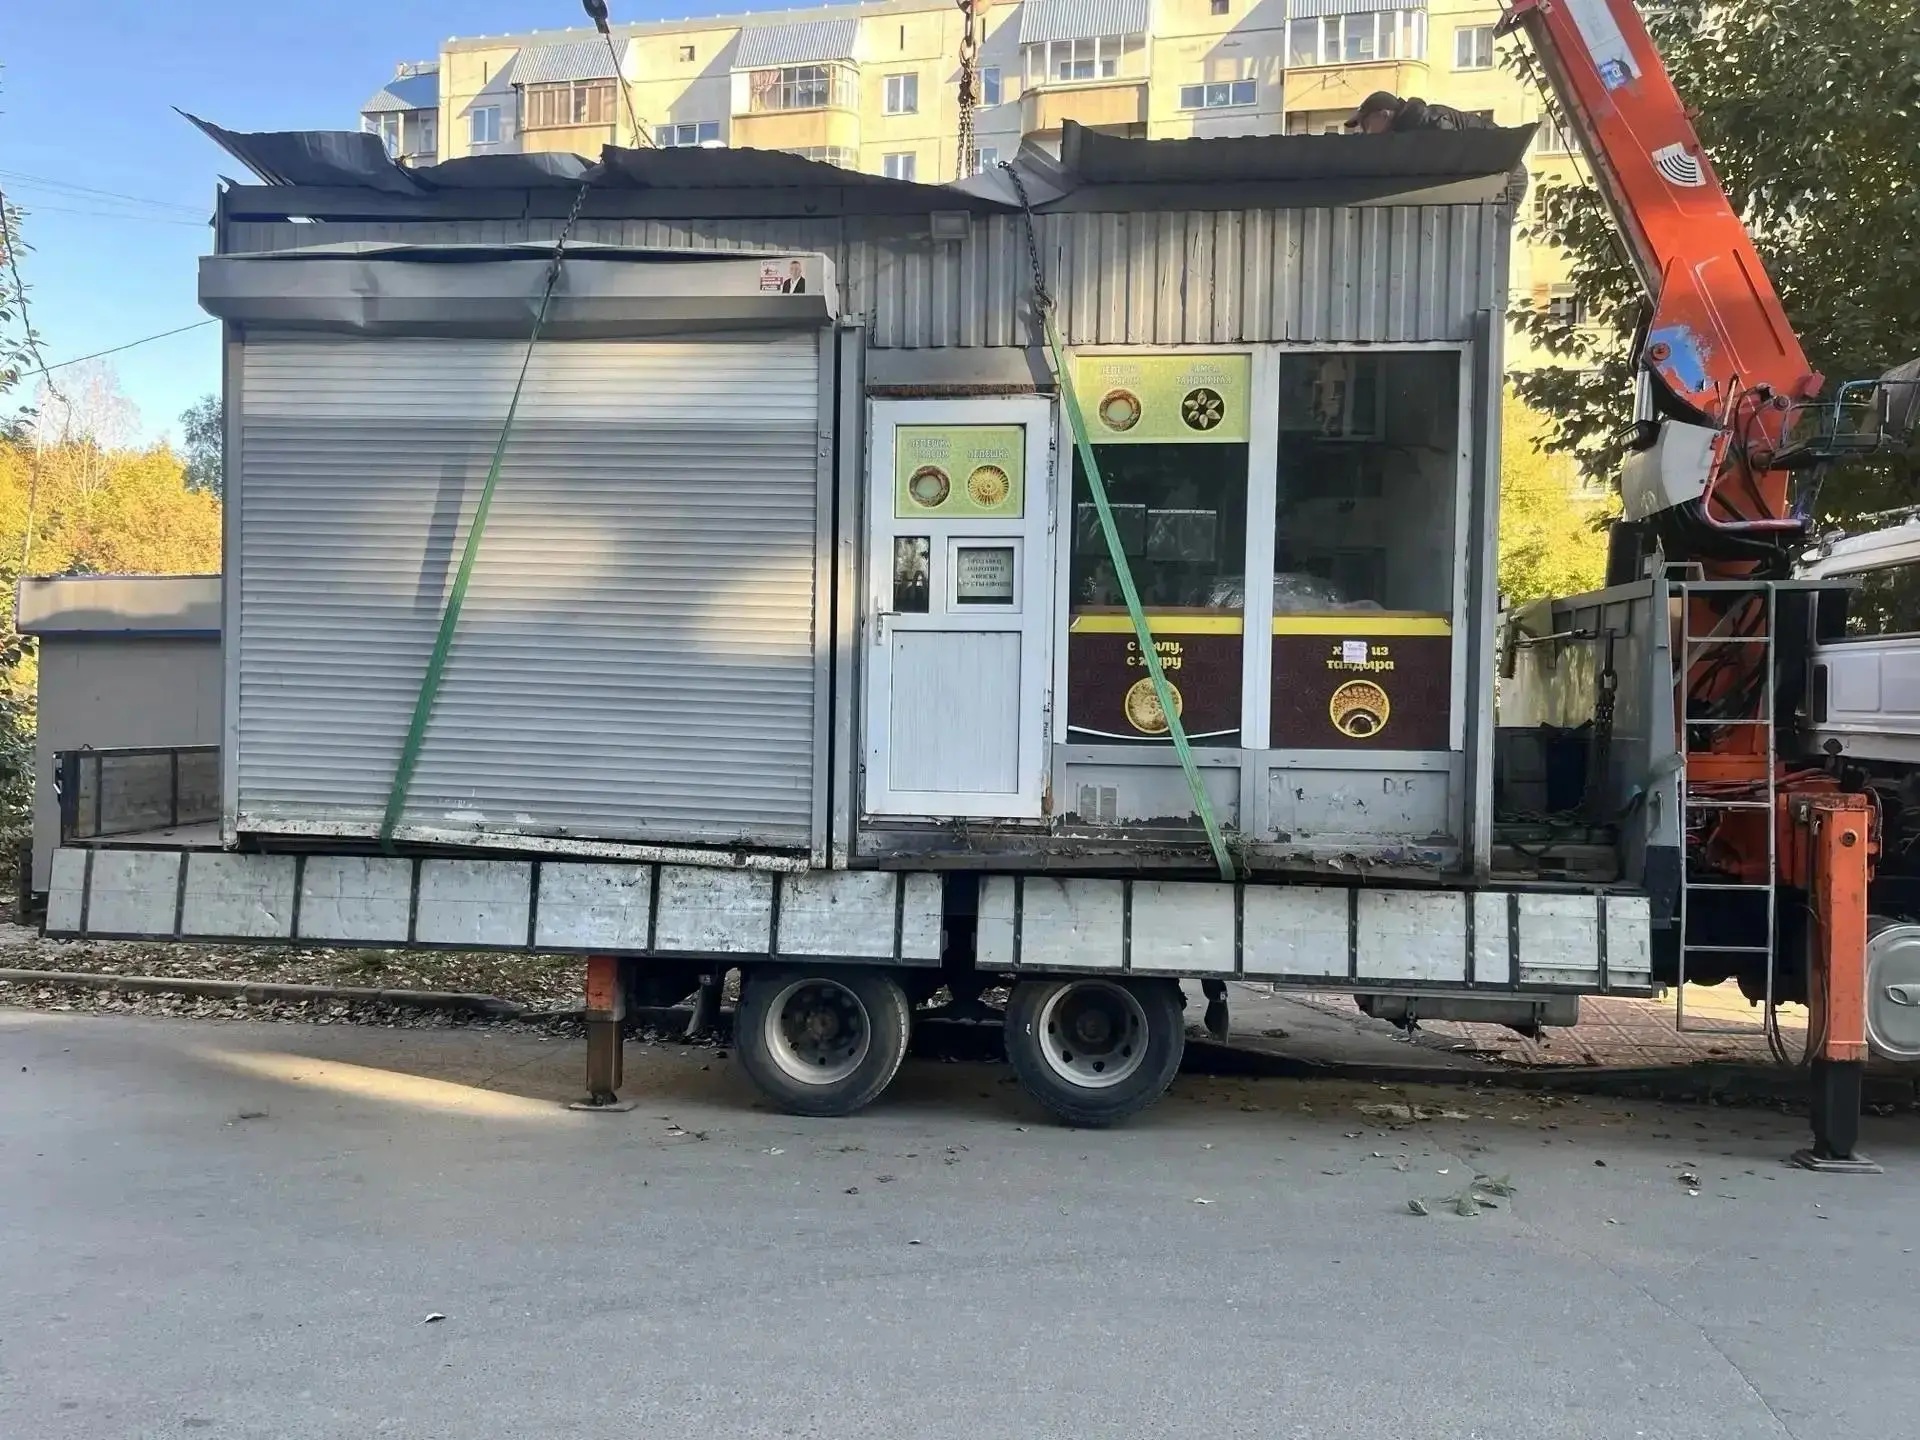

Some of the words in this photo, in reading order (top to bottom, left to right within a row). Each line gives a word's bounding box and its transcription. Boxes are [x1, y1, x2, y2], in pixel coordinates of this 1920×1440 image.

[1127, 641, 1136, 651] с
[1371, 646, 1389, 656] из
[1126, 656, 1136, 666] с
